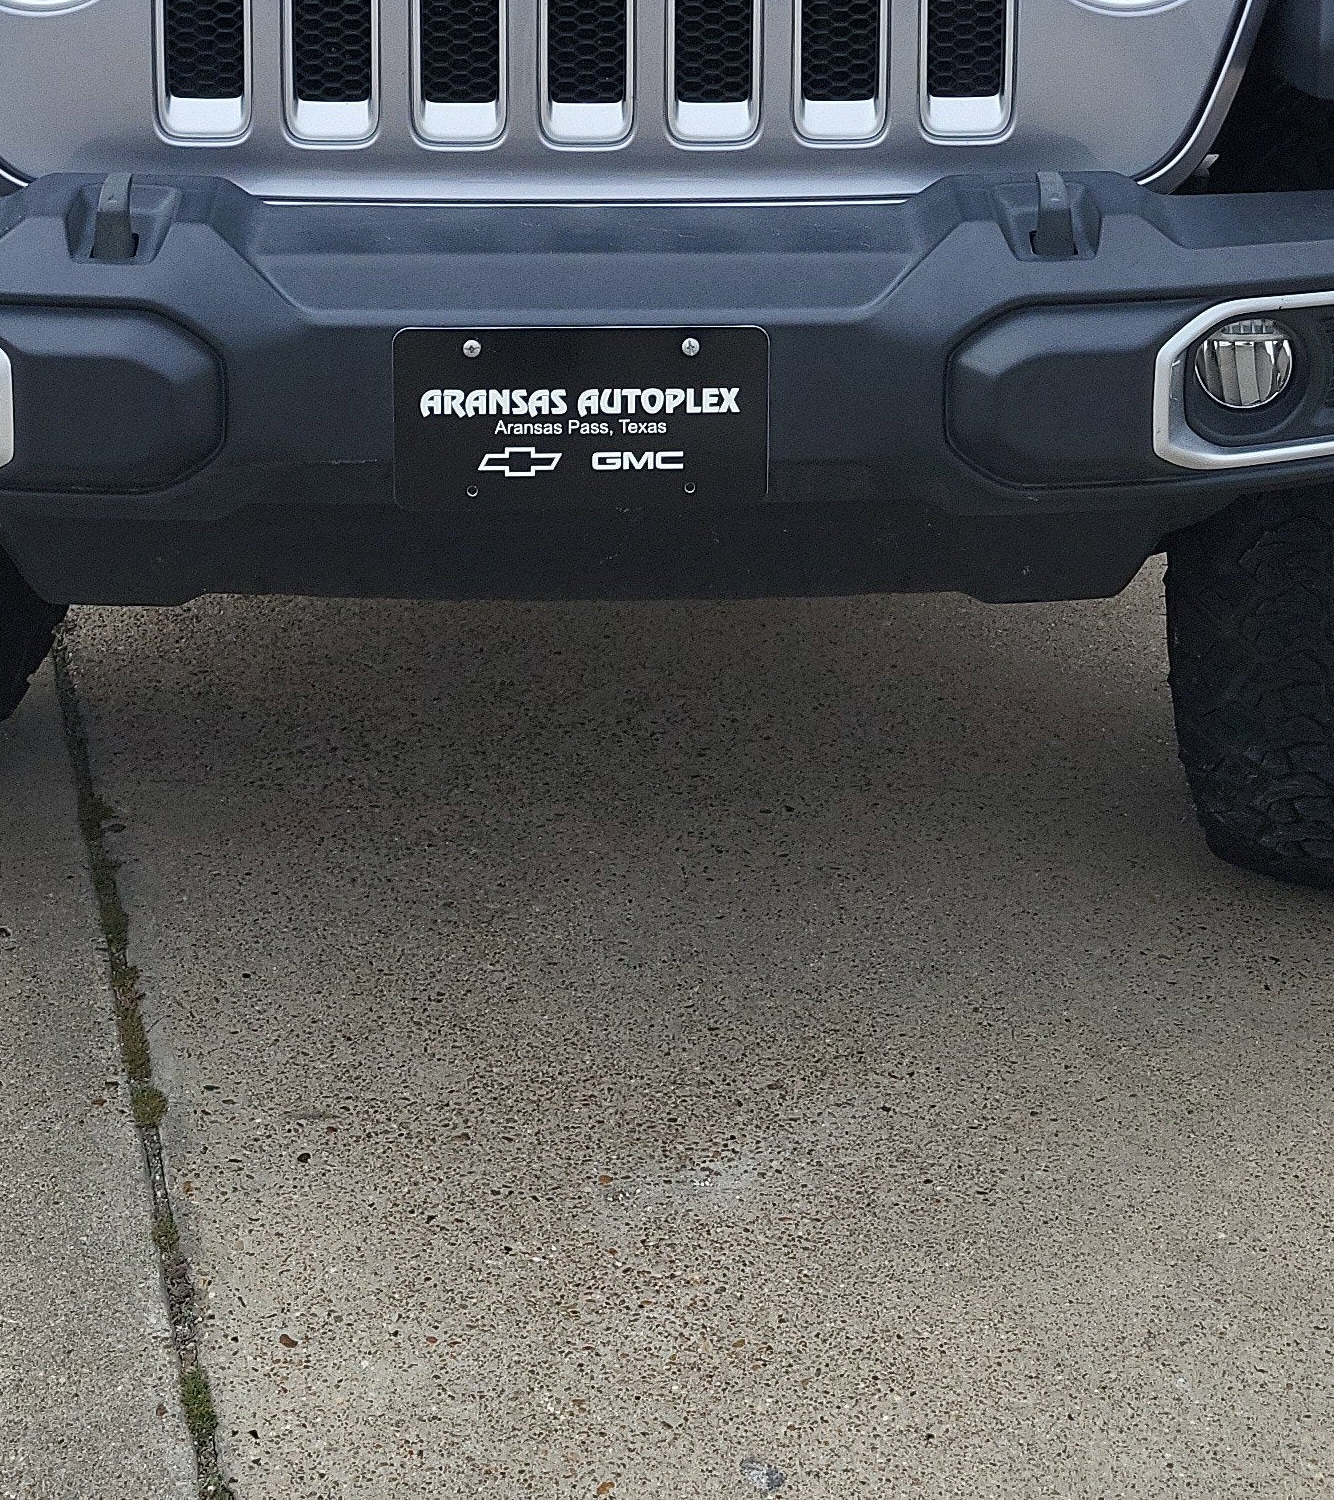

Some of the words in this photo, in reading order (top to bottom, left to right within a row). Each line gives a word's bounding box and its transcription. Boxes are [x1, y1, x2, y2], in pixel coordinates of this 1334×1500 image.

[420, 389, 567, 417] ARANSAS
[577, 387, 740, 417] AUTOPLEX
[494, 420, 562, 435] Aransas
[568, 420, 614, 436] Pass,
[619, 419, 667, 435] Texas
[591, 451, 684, 470] GMC
